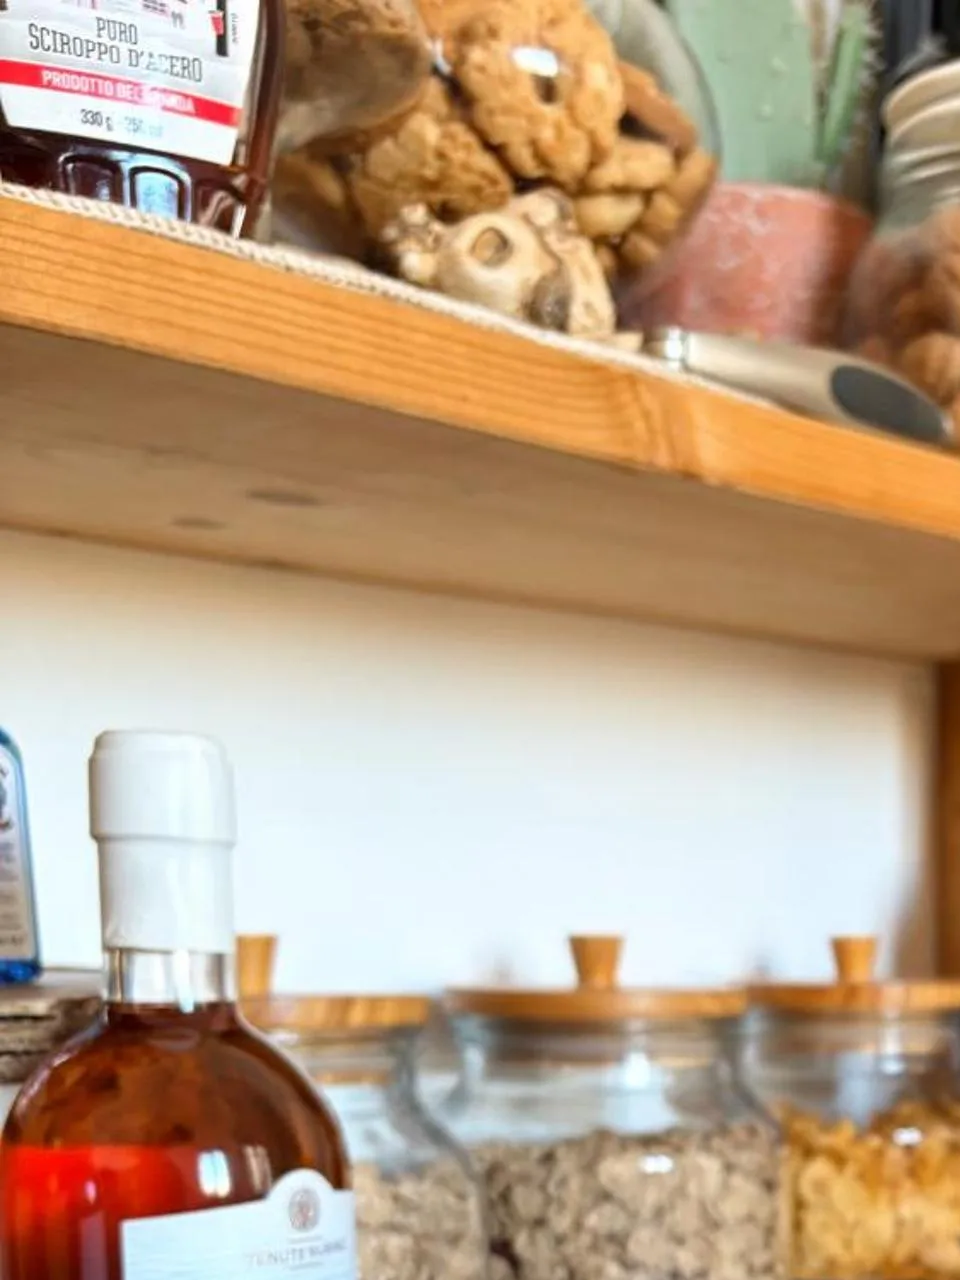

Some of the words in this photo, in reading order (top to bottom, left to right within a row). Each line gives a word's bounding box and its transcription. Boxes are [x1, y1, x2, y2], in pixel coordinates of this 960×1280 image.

[28, 22, 121, 65] SCIROPPO
[96, 16, 138, 46] PURO
[41, 69, 114, 98] PRODOTTO
[80, 108, 104, 128] 330
